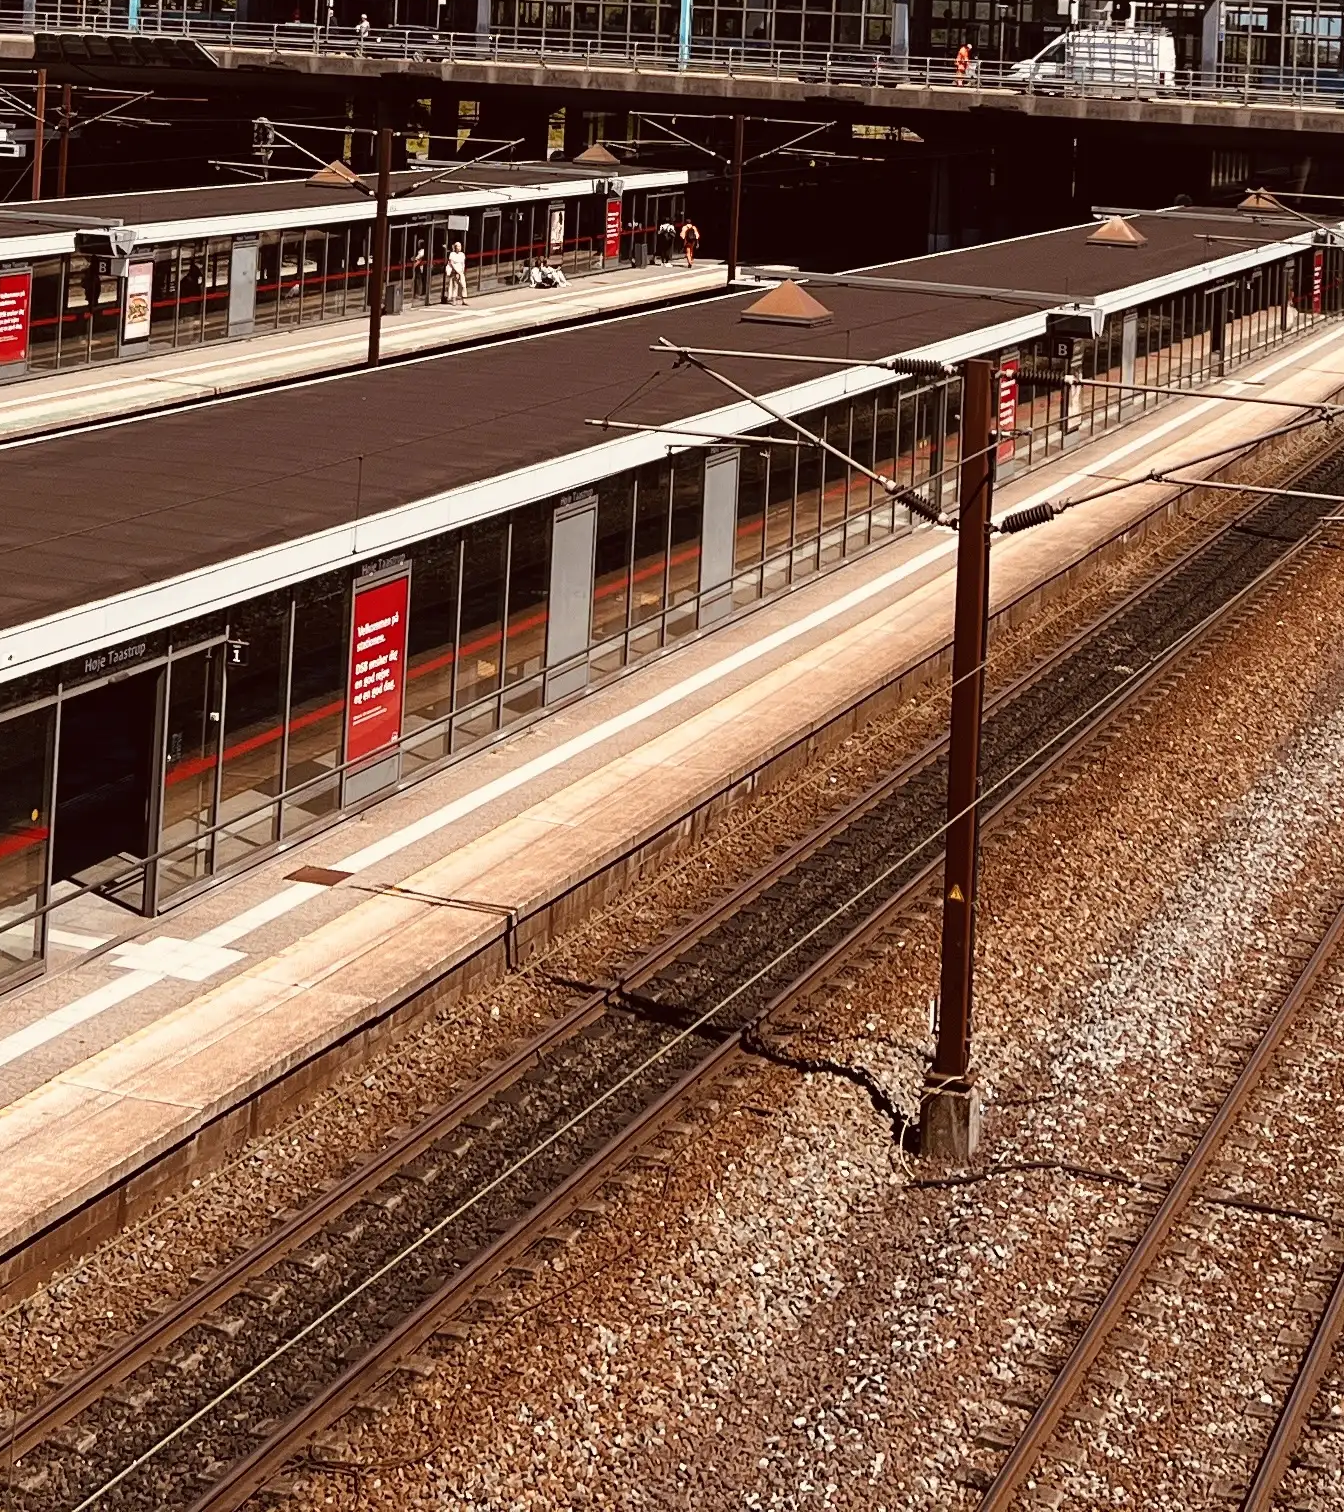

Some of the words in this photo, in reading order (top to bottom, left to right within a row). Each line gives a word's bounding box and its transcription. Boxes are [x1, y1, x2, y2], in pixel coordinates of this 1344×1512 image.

[99, 262, 107, 273] B
[1058, 343, 1068, 356] B
[107, 642, 146, 665] Taastrup
[232, 649, 241, 663] 1
